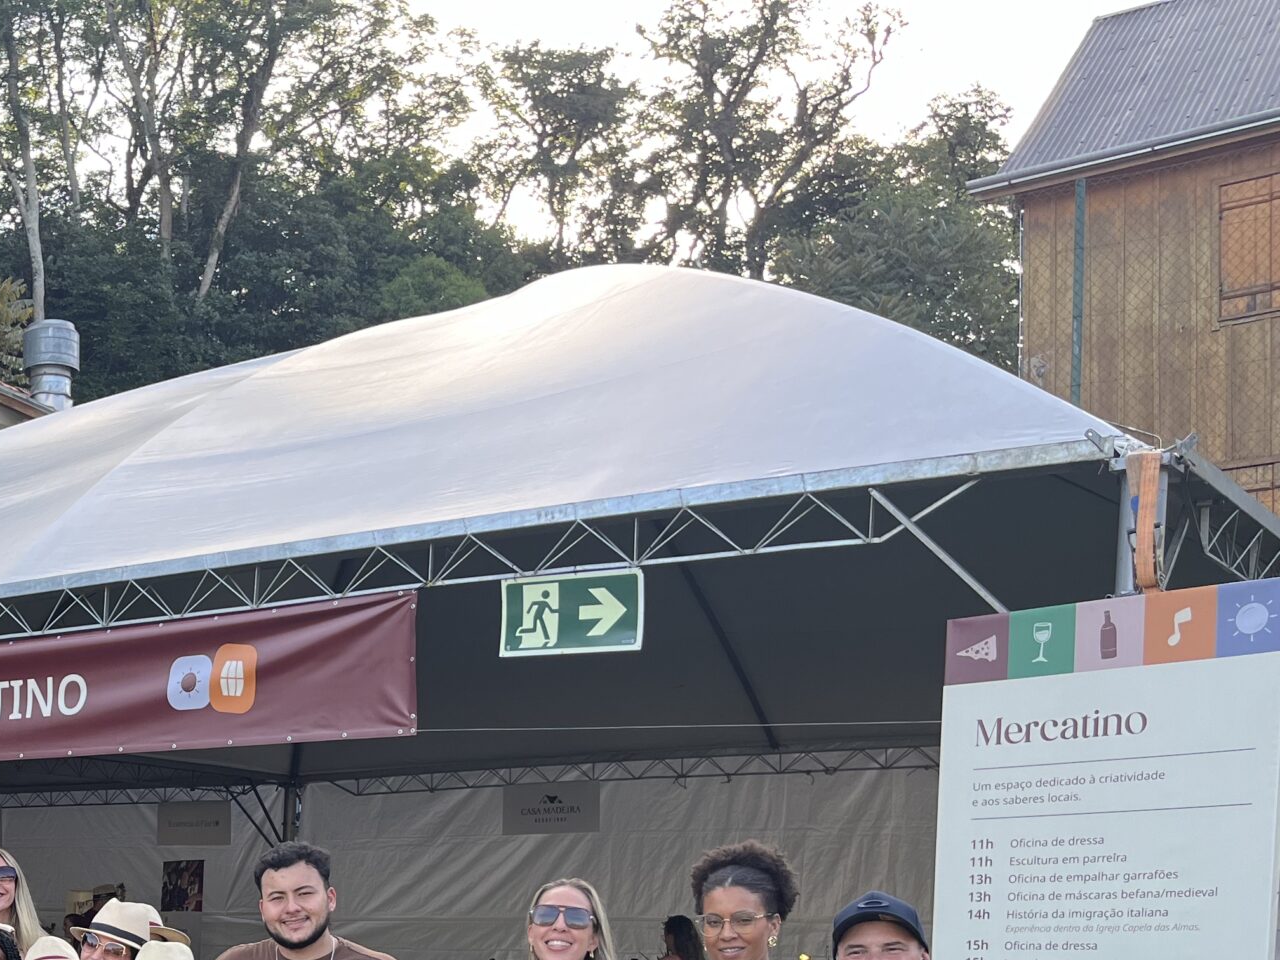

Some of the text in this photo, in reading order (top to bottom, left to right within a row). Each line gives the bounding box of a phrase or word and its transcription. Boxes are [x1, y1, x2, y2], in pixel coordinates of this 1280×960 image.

[975, 709, 1148, 747] Mercatino
[972, 770, 1165, 792] Um espaço dedicado à criatividade
[971, 792, 1082, 807] e aos saberes locais.
[520, 805, 581, 816] CASA MADEIRA
[970, 836, 1105, 850] 11h Oficina de dressa
[969, 853, 1127, 867] 11h Escultura em parreira
[969, 869, 1179, 885] 13h Oficina de empalhar garrafões
[968, 887, 1218, 903] 13h Oficina de máscaras befana/medieval
[967, 907, 1169, 921] 14h História da imigração italiana
[1054, 923, 1080, 932] dentro
[1082, 924, 1093, 932] da
[1095, 924, 1120, 934] Igreja
[1122, 923, 1152, 933] Capela
[1154, 923, 1170, 932] das
[966, 940, 1098, 951] 15h Oficina de dressa
